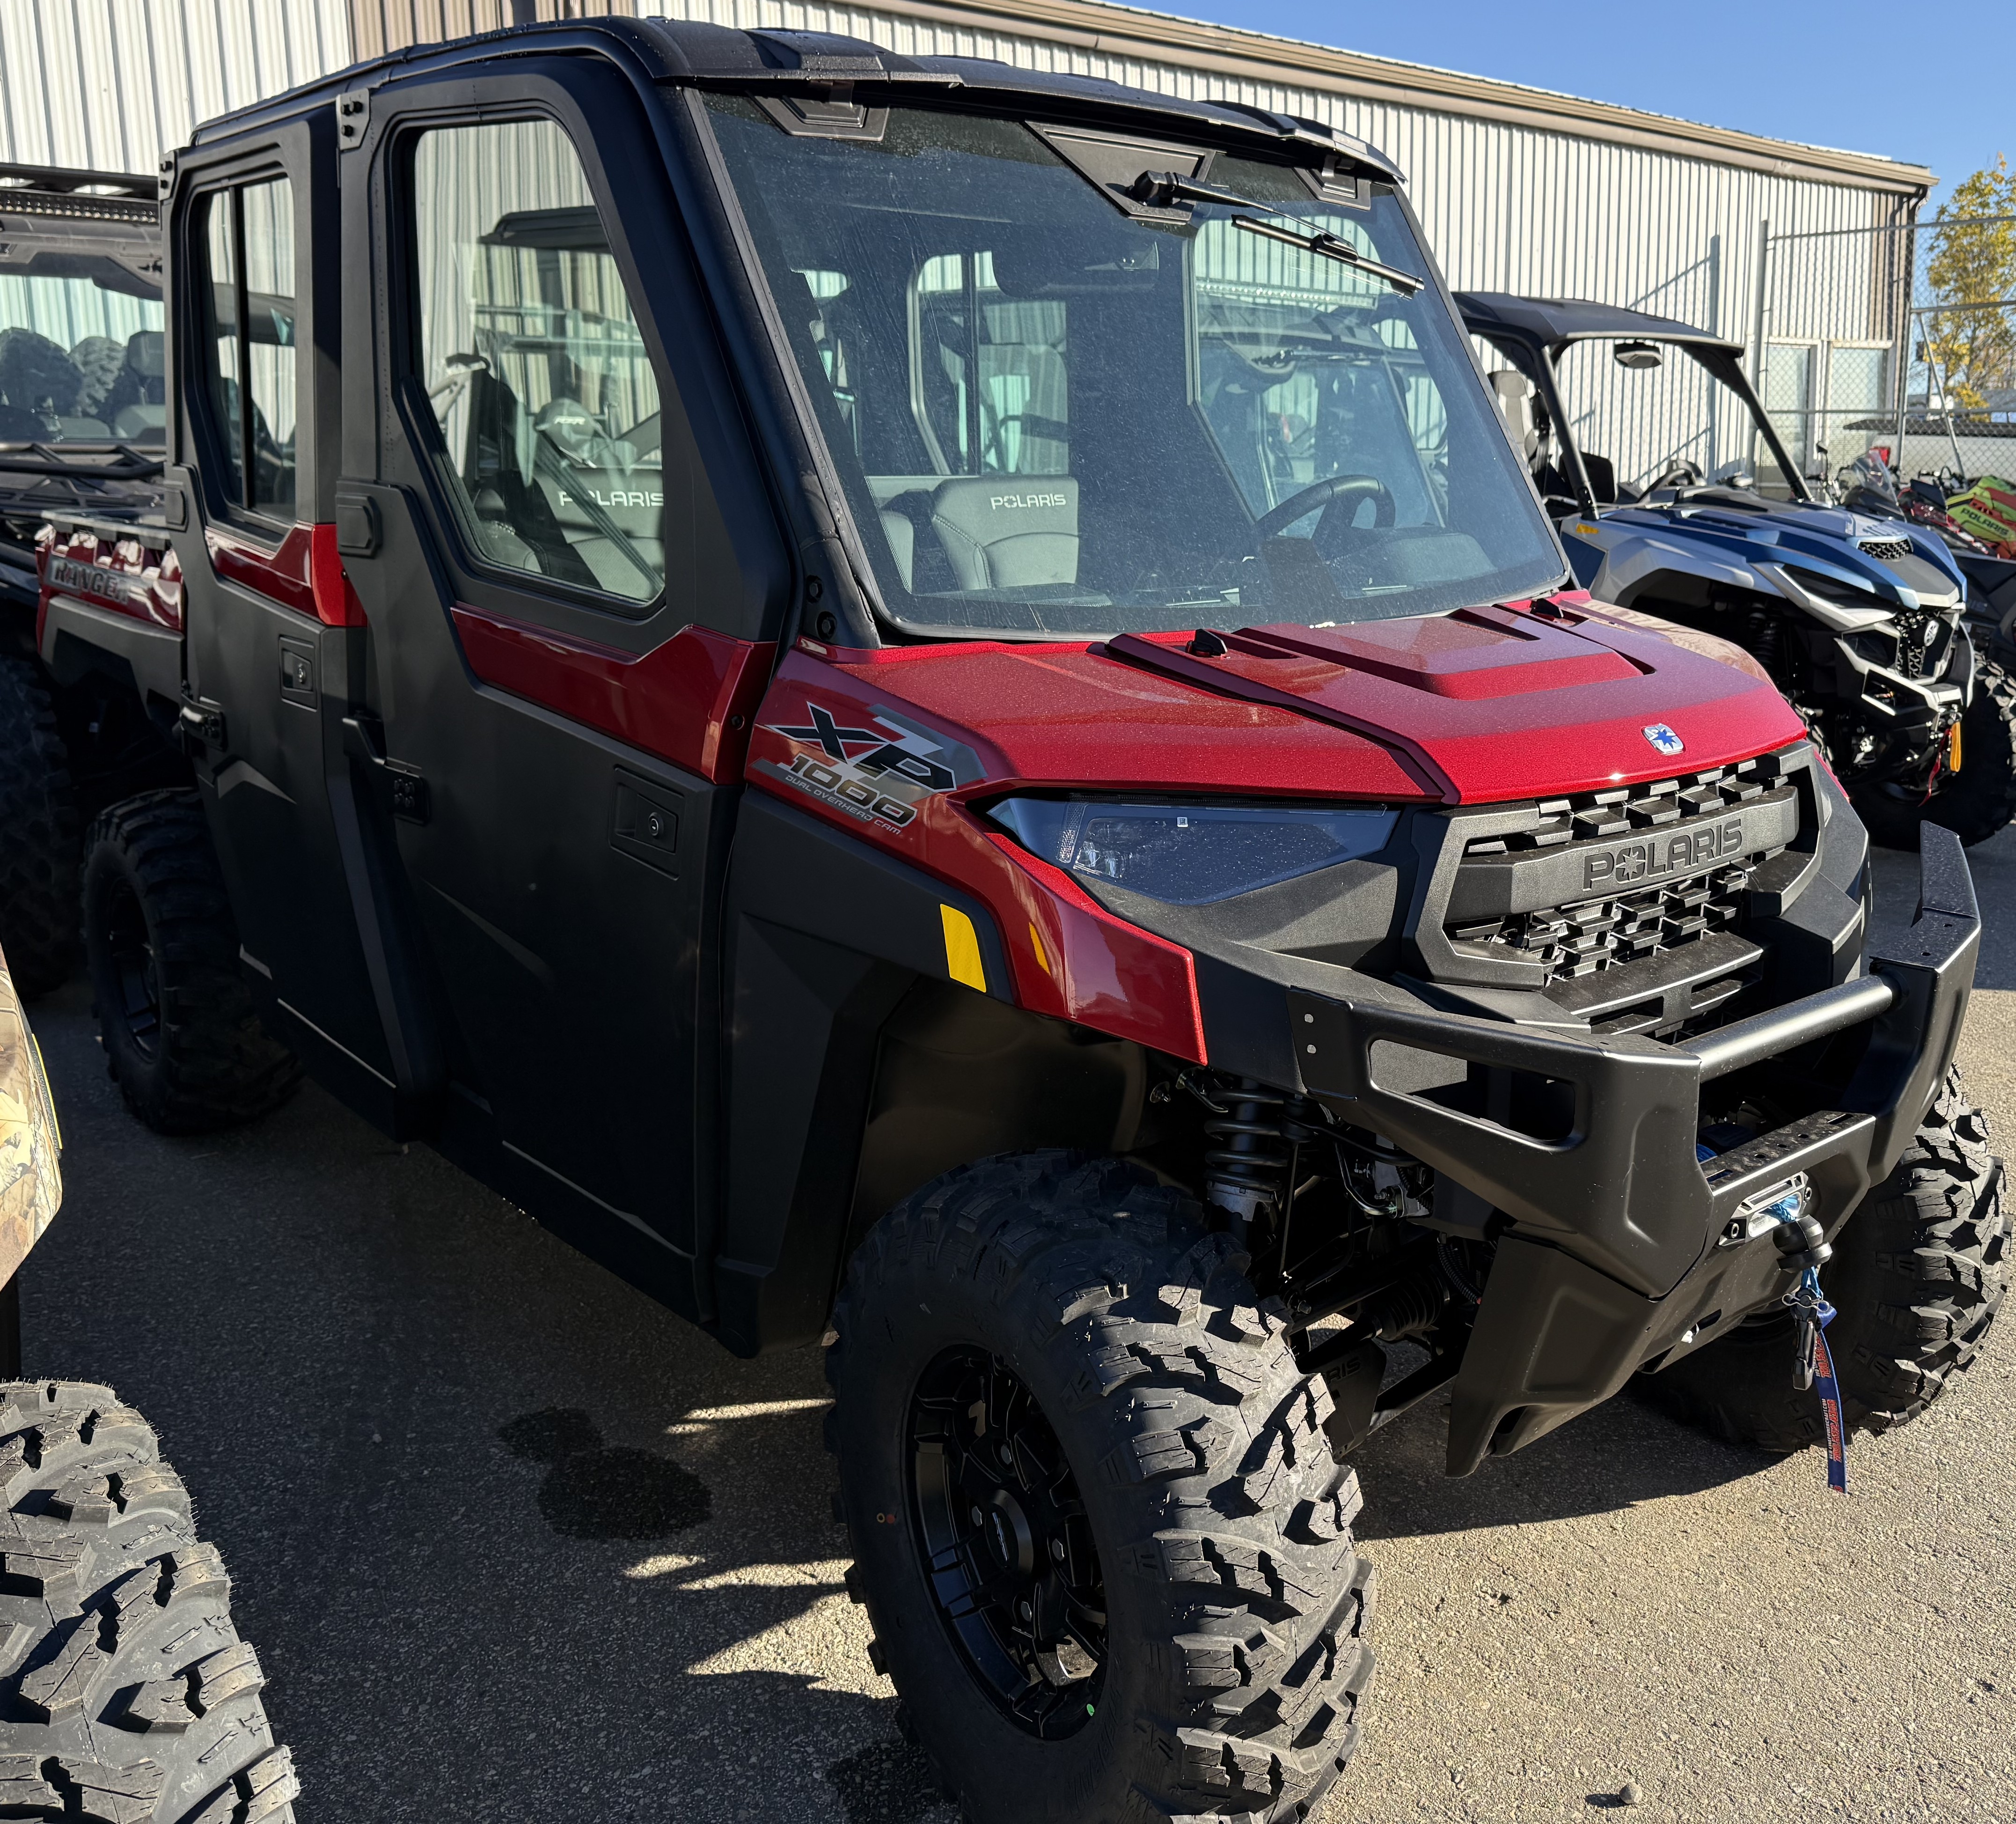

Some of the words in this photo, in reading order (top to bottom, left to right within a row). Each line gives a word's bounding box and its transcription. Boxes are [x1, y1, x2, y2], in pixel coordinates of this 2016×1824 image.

[558, 490, 664, 507] PLARIS
[990, 493, 1066, 510] POLARIS
[1960, 507, 2009, 535] POLARIS
[52, 559, 128, 604] RANGER
[764, 701, 957, 791] XP
[785, 775, 812, 792] DUAL
[814, 789, 873, 821] OVERHEAD
[874, 819, 901, 835] CAM
[790, 752, 918, 828] 1000
[1583, 818, 1742, 891] POLARIS
